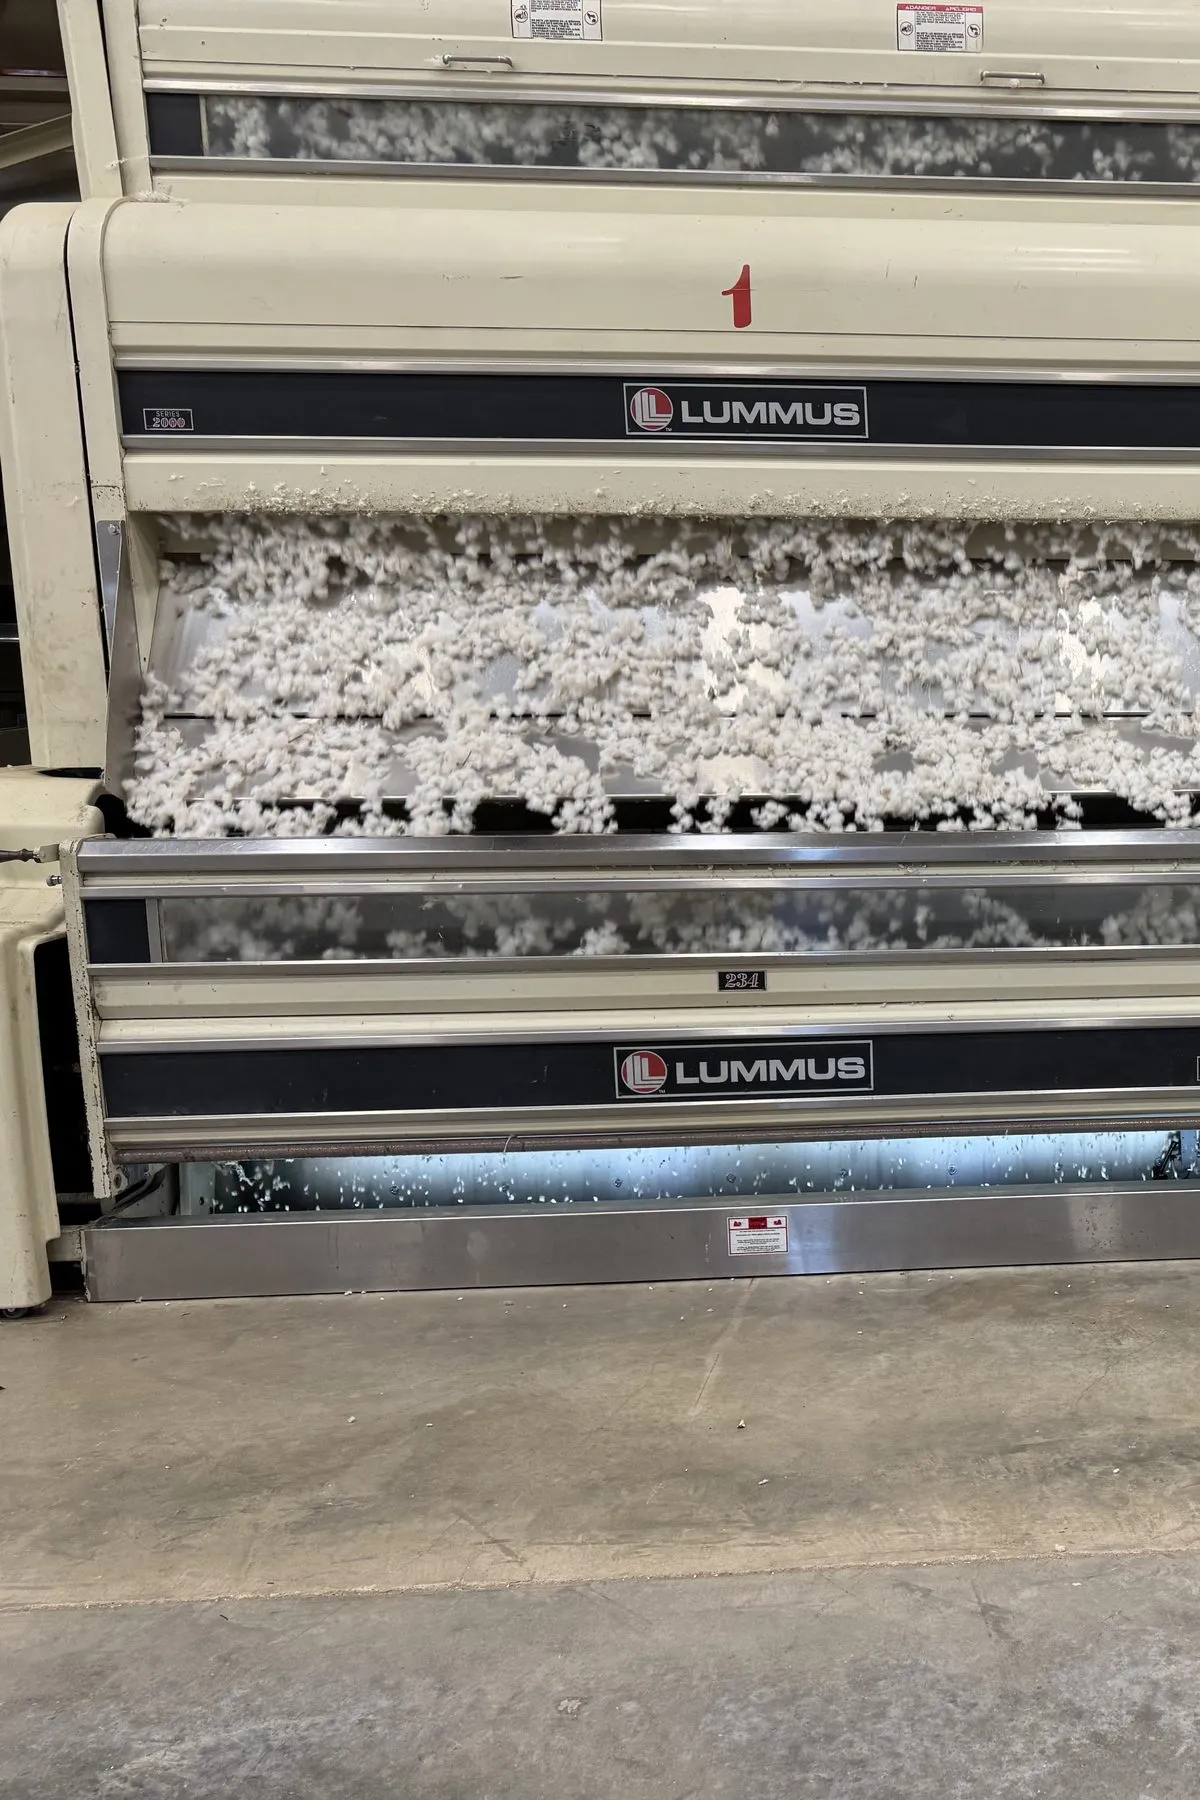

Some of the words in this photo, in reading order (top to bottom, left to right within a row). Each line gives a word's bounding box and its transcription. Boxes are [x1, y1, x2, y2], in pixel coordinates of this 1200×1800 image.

[721, 264, 752, 328] 1
[152, 416, 186, 428] 2000
[155, 410, 180, 418] SERIES
[681, 400, 861, 426] LUMMUS
[724, 972, 760, 989] 234
[675, 1057, 866, 1084] LUMMUS
